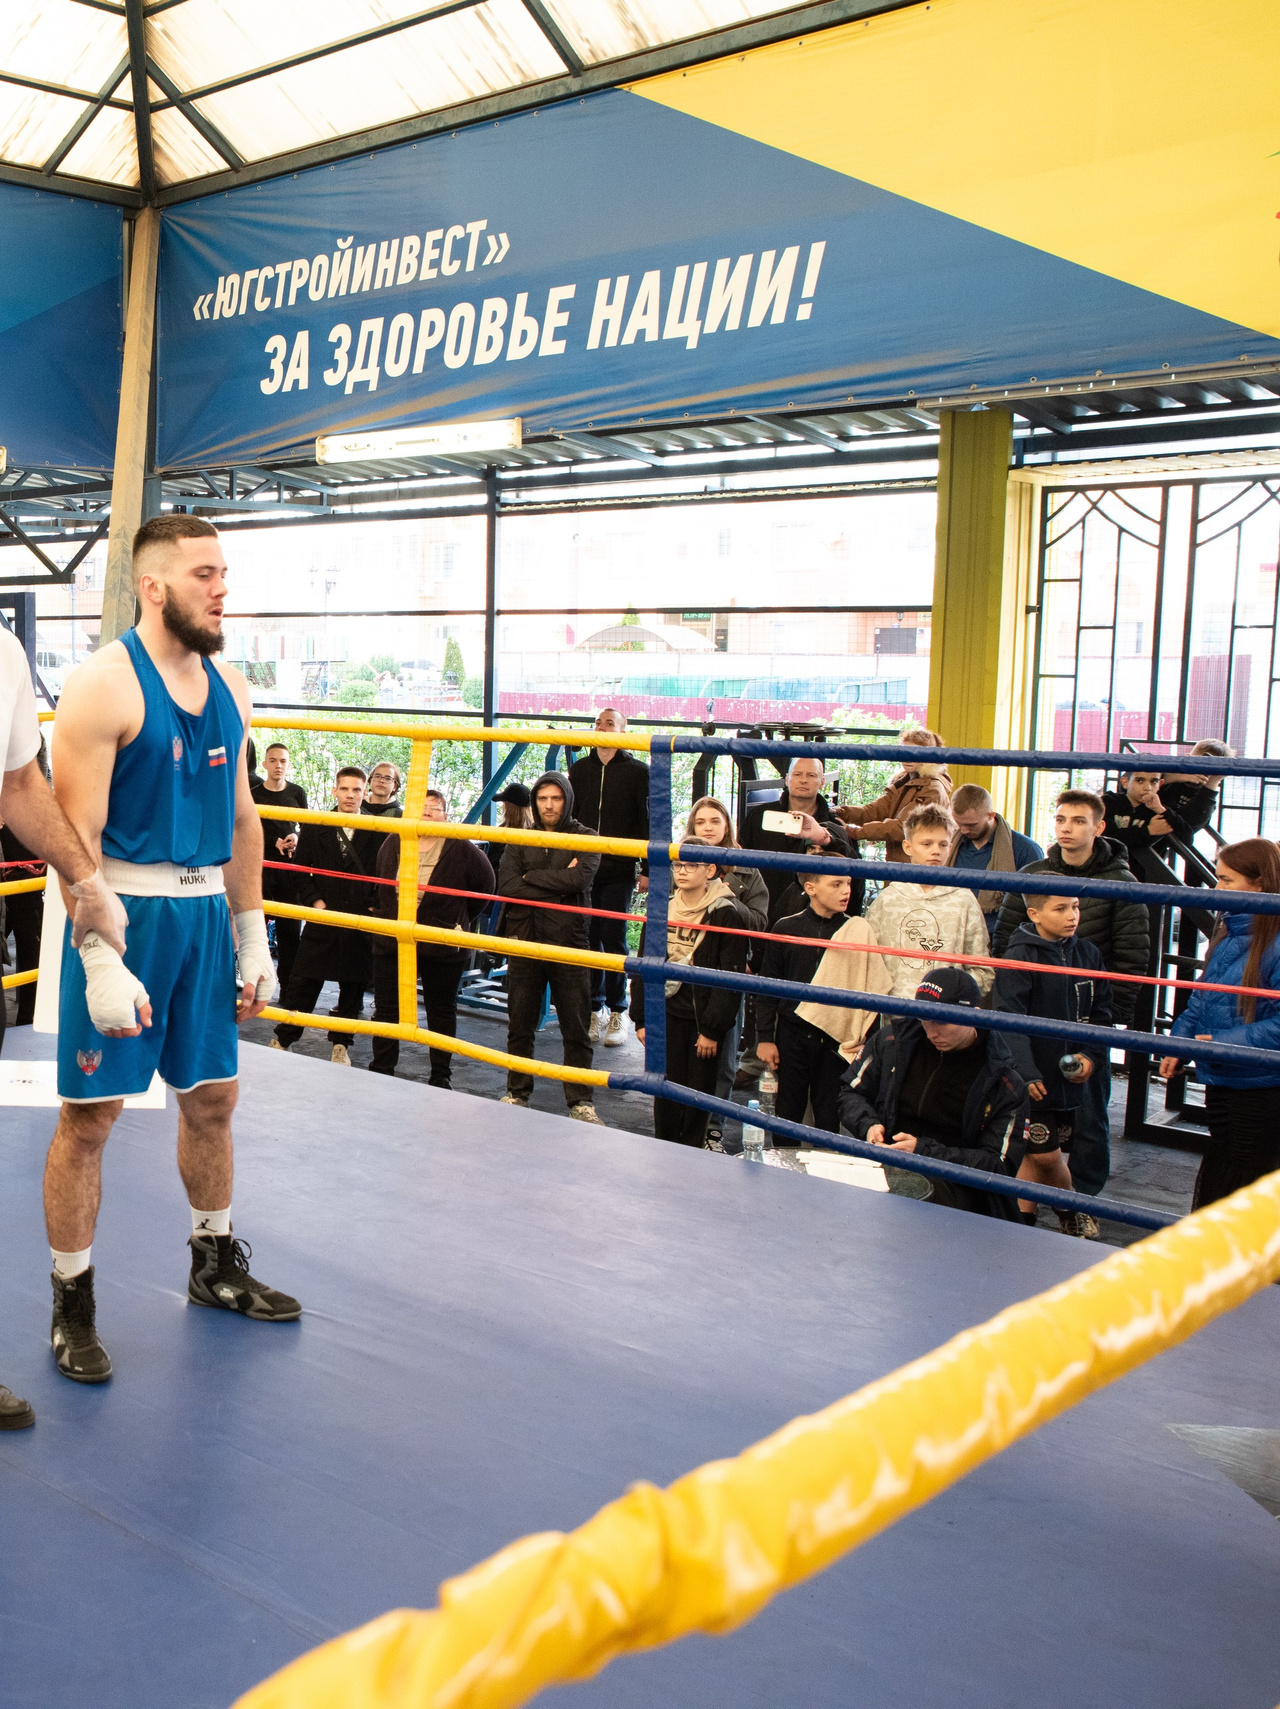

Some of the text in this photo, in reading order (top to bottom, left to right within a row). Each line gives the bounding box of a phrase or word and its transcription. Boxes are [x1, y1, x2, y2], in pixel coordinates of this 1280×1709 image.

[193, 219, 511, 322] «ЮГСТРОЙИНВЕСТ»
[259, 240, 827, 396] ЗА ЗДОРОВЬЕ НАЦИИ!
[179, 874, 206, 885] HUKK
